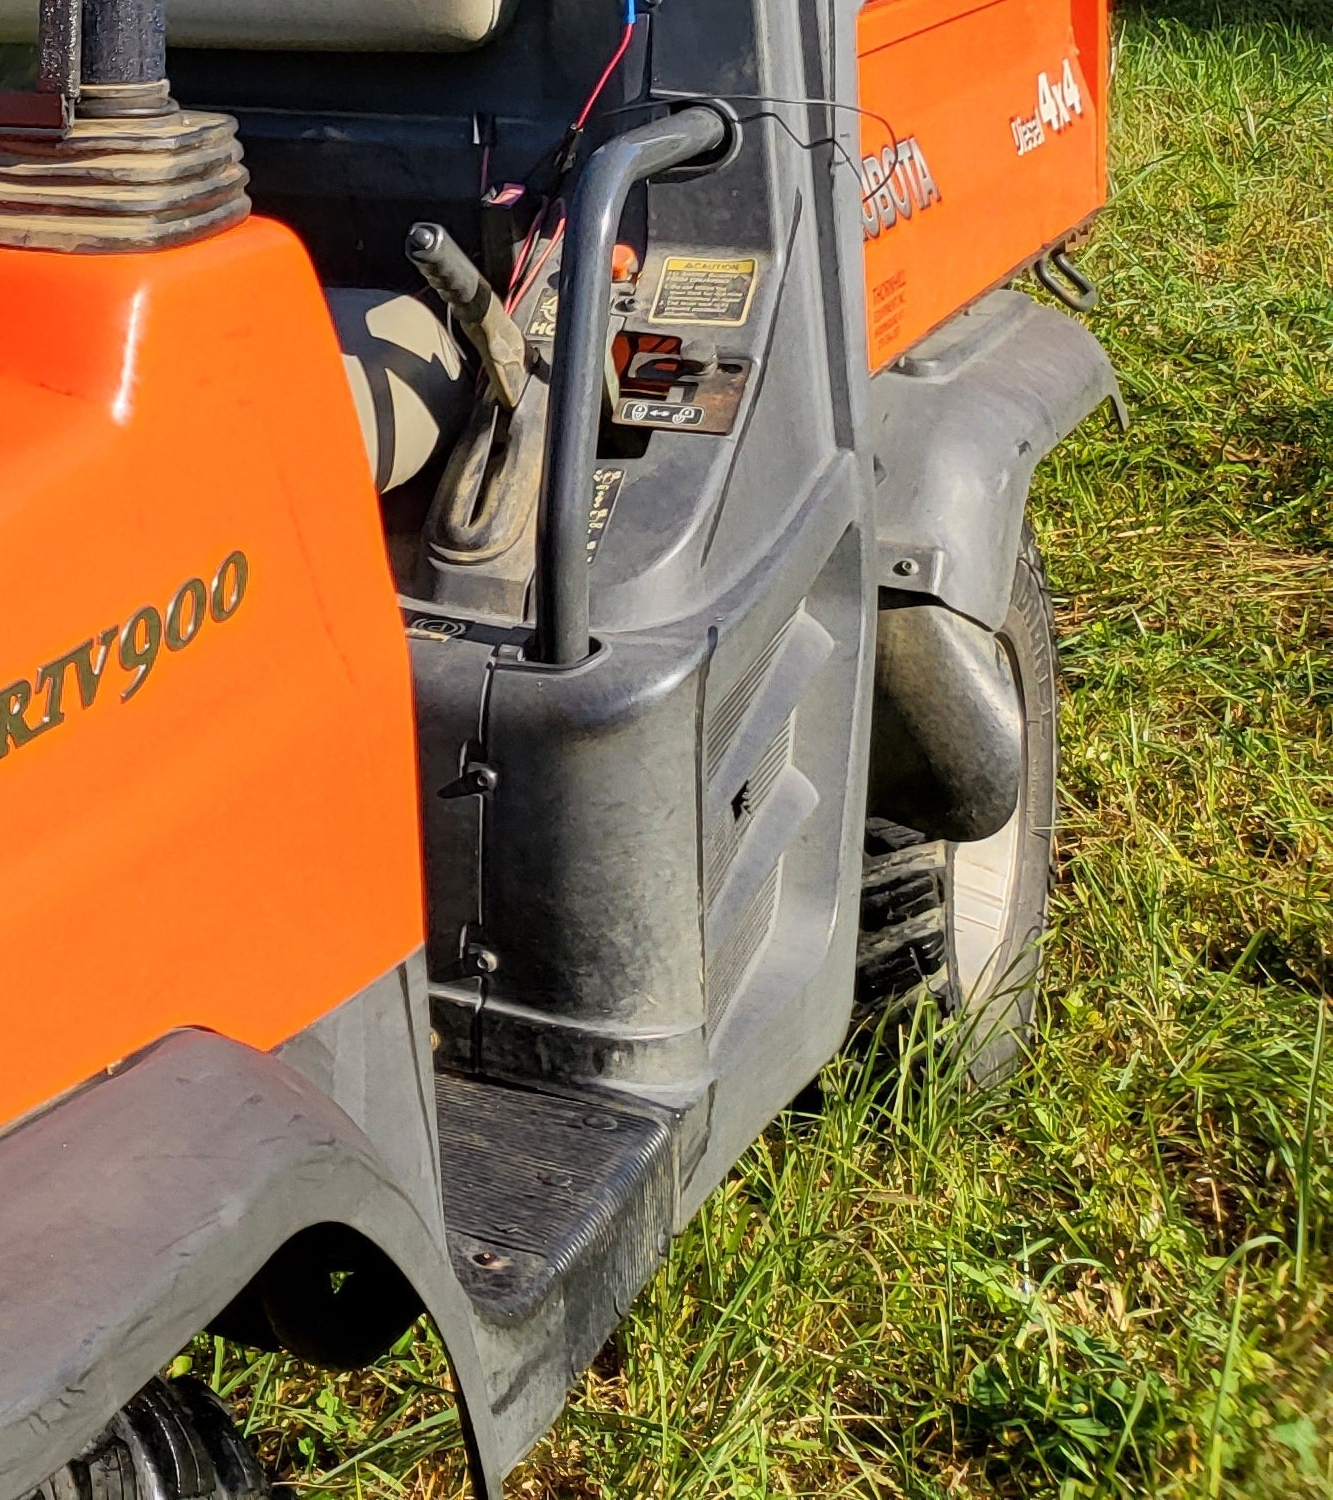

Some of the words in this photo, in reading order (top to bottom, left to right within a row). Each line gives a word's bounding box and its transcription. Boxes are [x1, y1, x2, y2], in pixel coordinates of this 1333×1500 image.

[1038, 58, 1083, 132] 4x4
[861, 136, 942, 242] UBOTA
[693, 262, 740, 271] CAUTION
